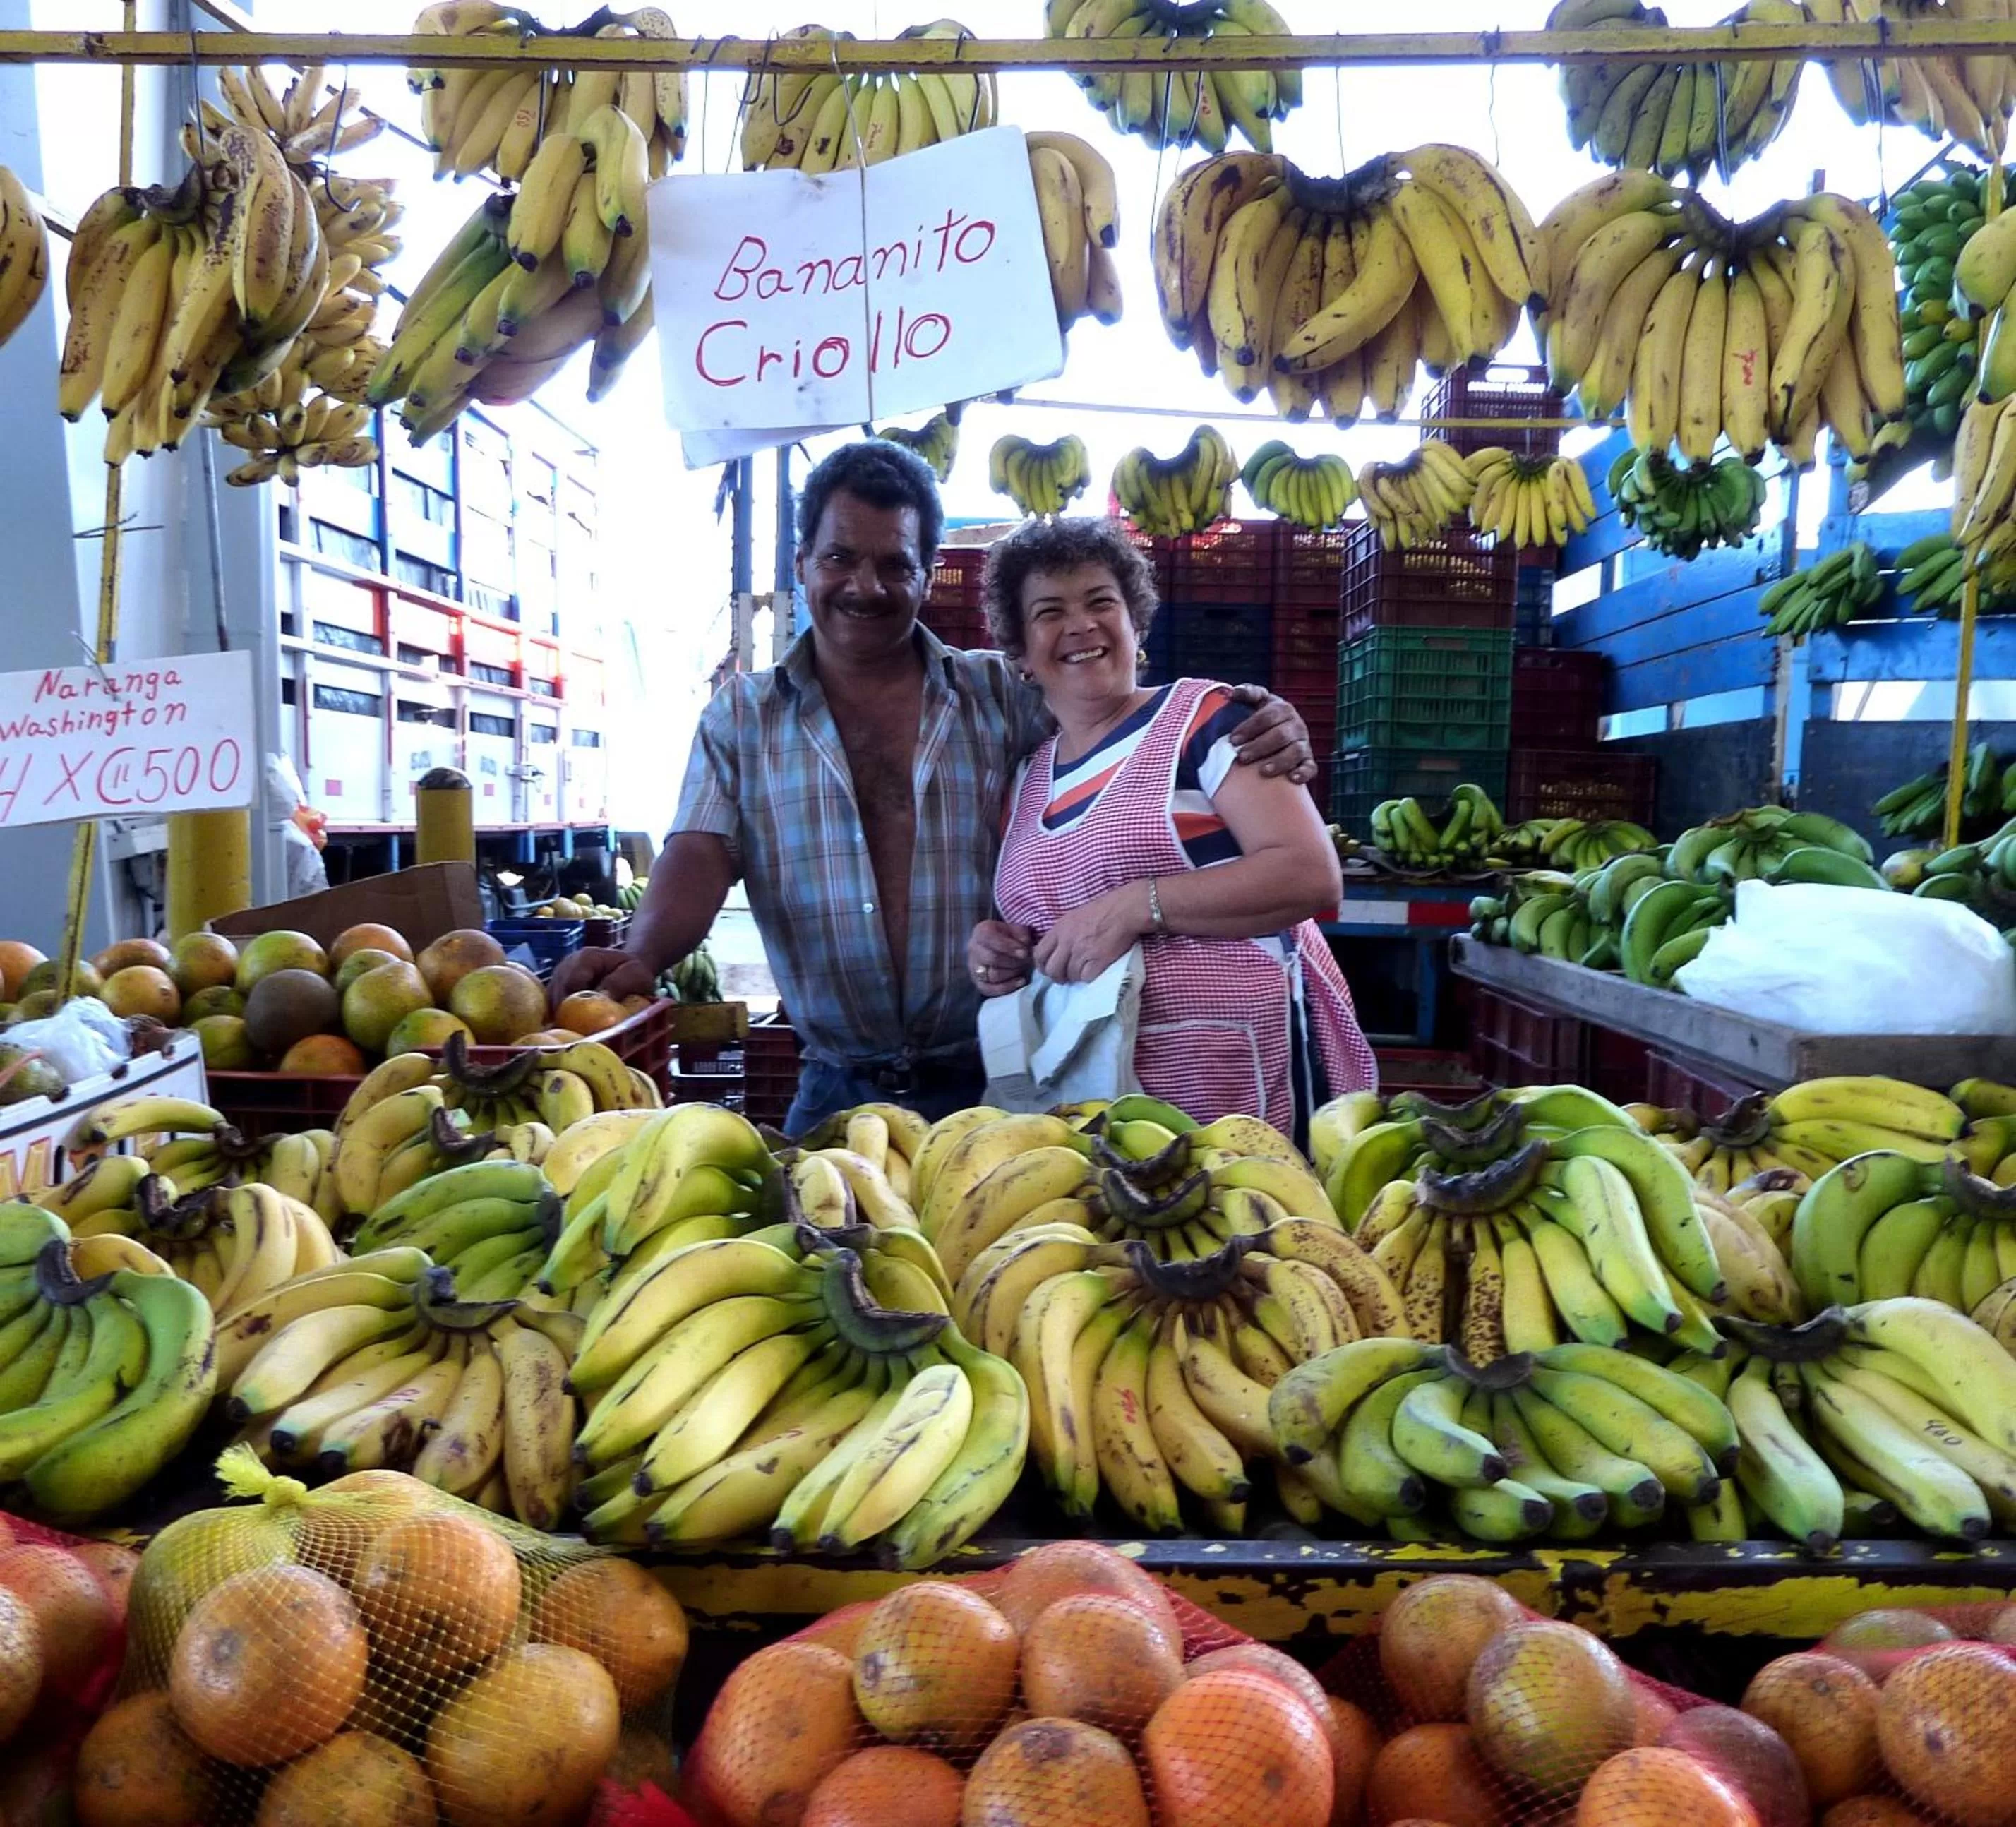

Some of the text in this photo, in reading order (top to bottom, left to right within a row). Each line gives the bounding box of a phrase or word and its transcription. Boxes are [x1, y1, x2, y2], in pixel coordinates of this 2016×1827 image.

[714, 208, 995, 301] Bananito
[695, 306, 951, 387] Criollo
[0, 701, 187, 741] Washington
